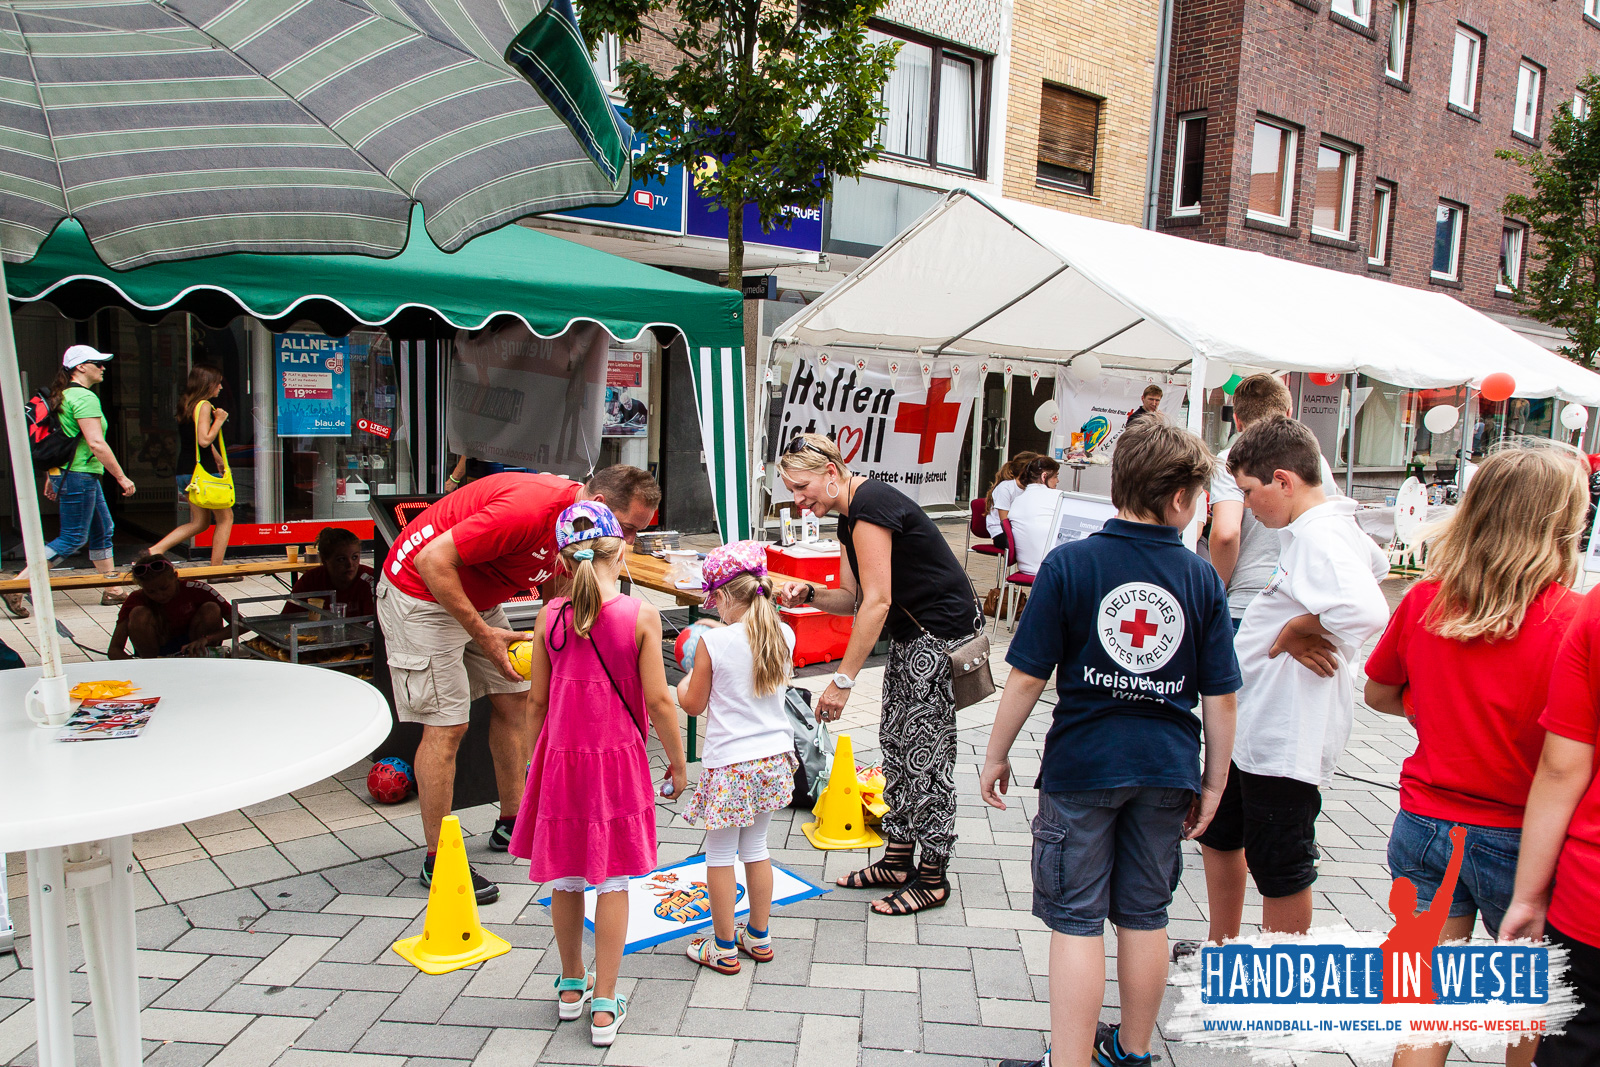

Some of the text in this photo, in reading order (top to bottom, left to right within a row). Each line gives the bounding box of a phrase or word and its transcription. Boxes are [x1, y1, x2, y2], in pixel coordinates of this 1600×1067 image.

[654, 194, 668, 206] TV
[742, 284, 765, 296] ymedia
[281, 338, 344, 350] ALLNET-
[281, 352, 320, 364] FLAT
[788, 358, 896, 415] Helfen
[1303, 394, 1339, 404] MARTIN'S
[1302, 406, 1338, 414] EVOLUTION
[314, 419, 346, 427] blau.de
[869, 469, 899, 483] Rettet
[924, 470, 947, 483] Betreut
[528, 569, 552, 583] JH
[1105, 589, 1176, 625] DEUTSCHES
[1104, 627, 1174, 666] ROTES KREUZ
[670, 905, 701, 924] DU
